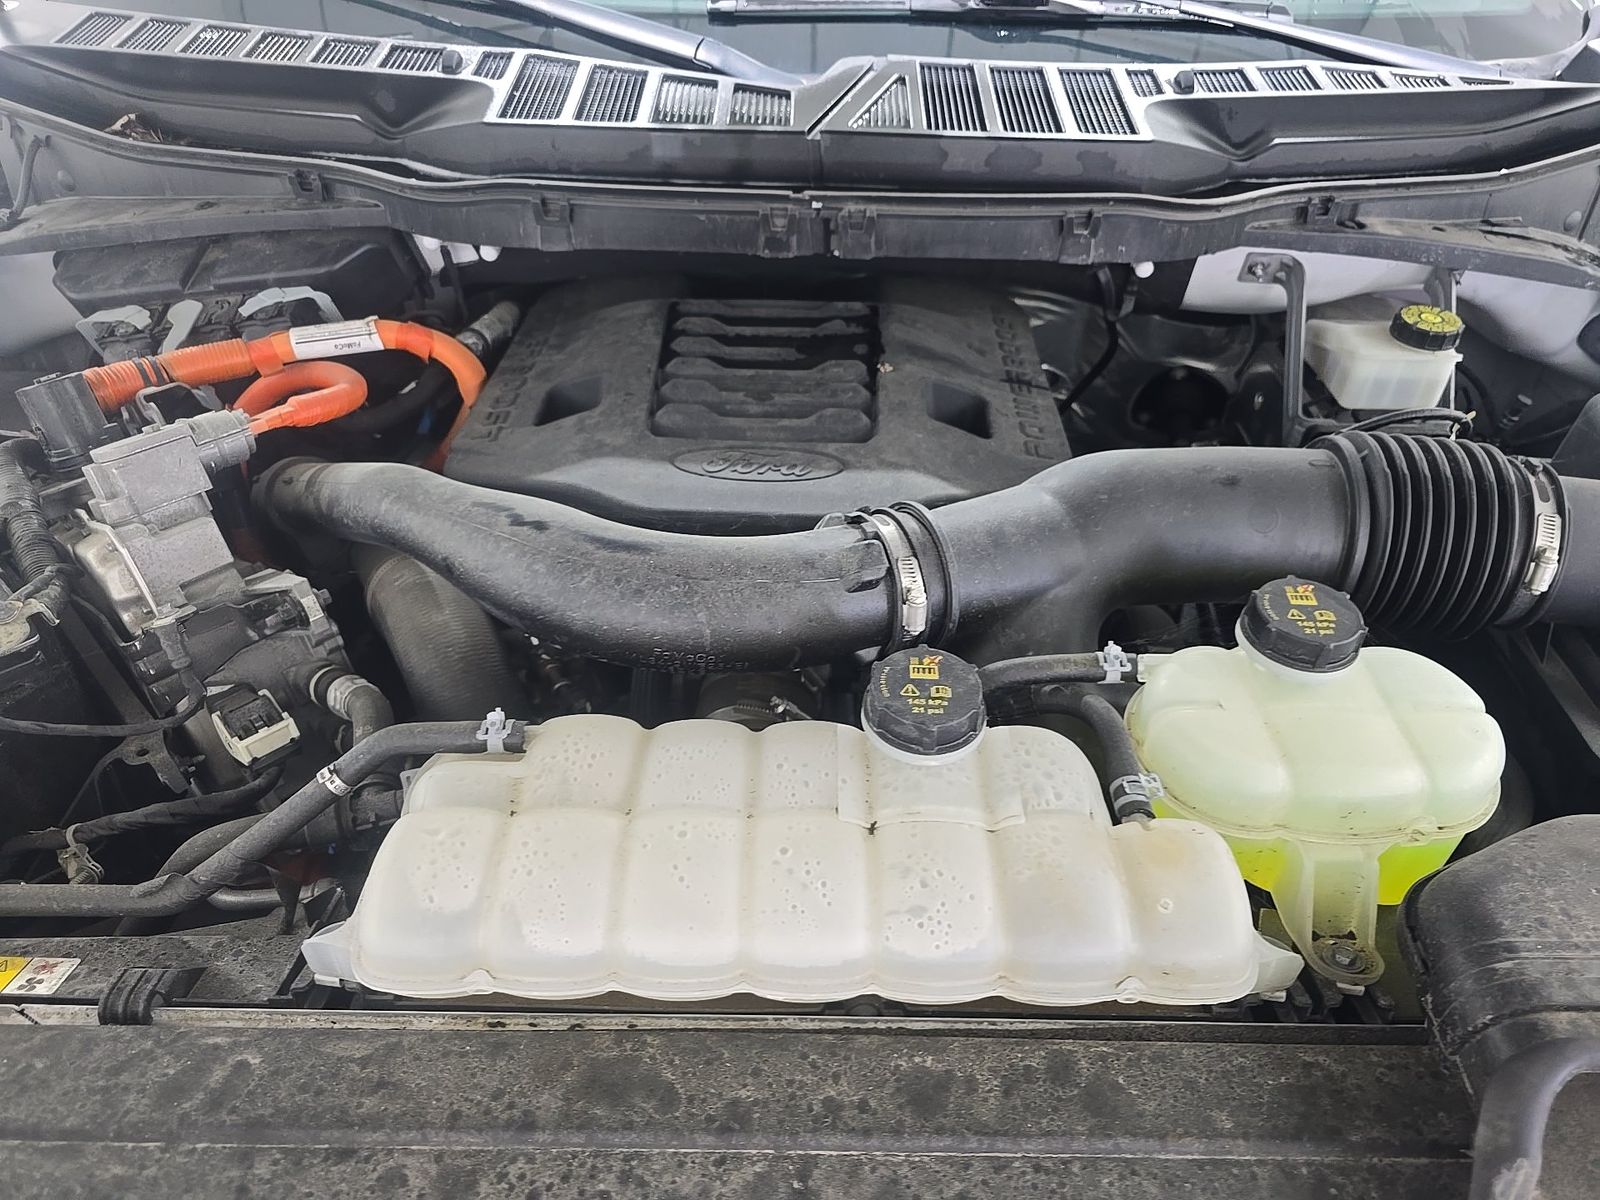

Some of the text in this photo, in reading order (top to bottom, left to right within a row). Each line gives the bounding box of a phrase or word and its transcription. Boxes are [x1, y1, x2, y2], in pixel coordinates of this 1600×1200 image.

[700, 451, 813, 478] Ford
[927, 698, 949, 706] kPa
[927, 707, 944, 715] psi
